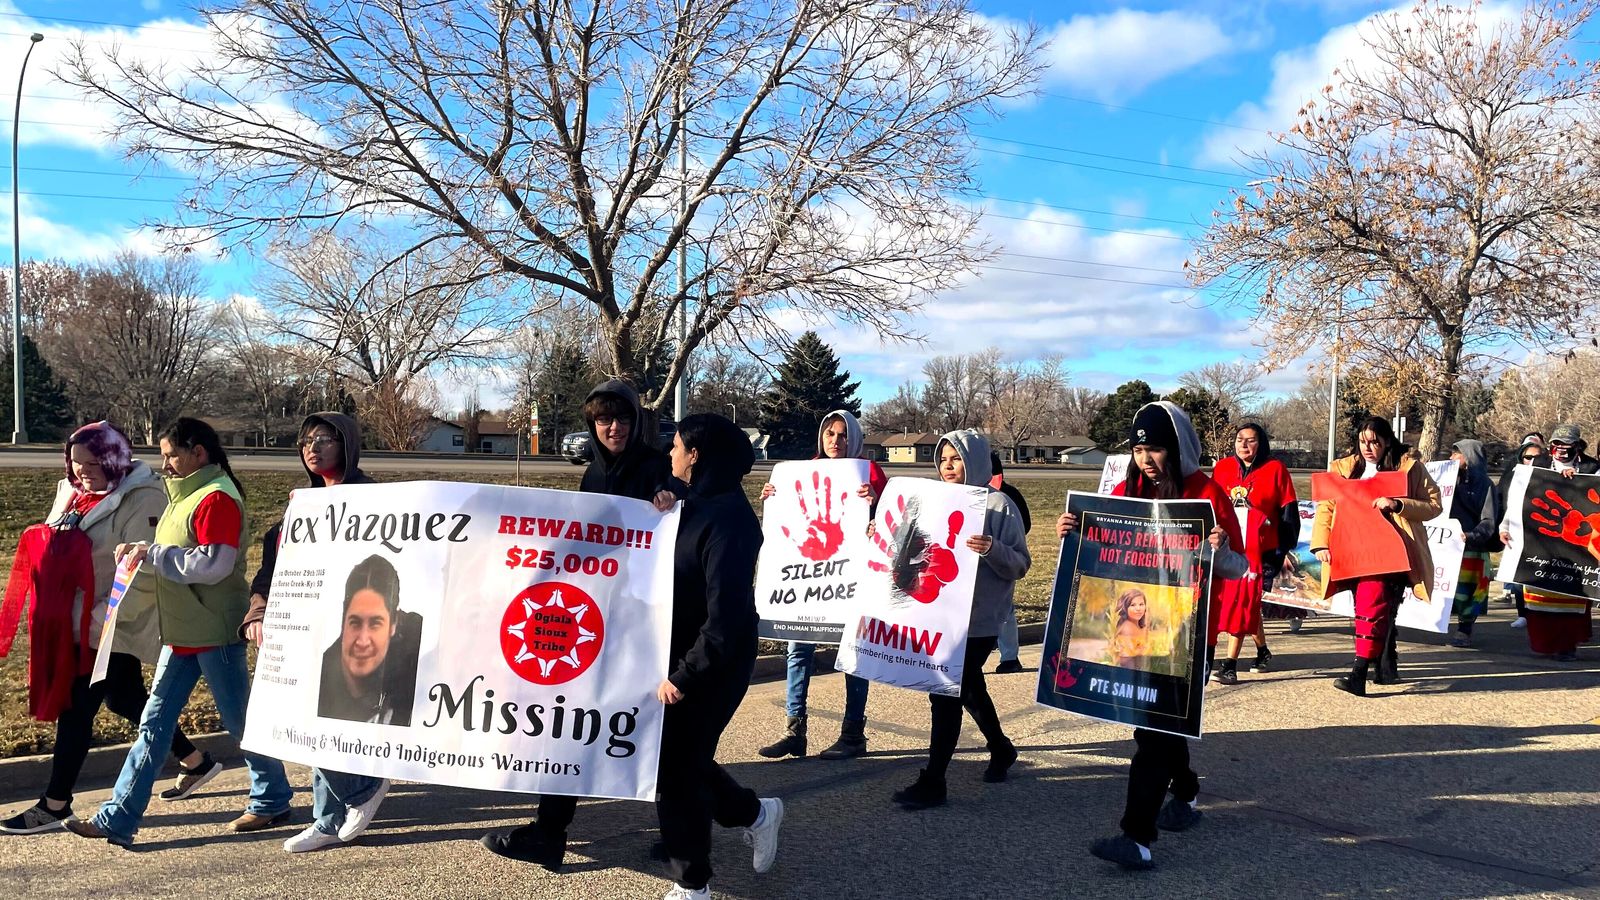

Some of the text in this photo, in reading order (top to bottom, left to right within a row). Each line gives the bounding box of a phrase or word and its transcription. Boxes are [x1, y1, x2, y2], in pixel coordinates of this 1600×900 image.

[325, 502, 472, 553] Vazquez
[498, 515, 654, 549] REWARD!!!
[1087, 526, 1200, 550] ALWAYS REMEMBERED
[505, 545, 619, 577] $25,000
[781, 558, 850, 581] SILENT
[1099, 547, 1184, 571] NOT FORGOTTEN
[769, 582, 857, 604] NO MORE
[534, 612, 572, 625] Oglala
[787, 625, 809, 633] HUMAN
[534, 626, 568, 638] Sioux
[855, 615, 943, 656] MMIW
[533, 640, 566, 652] Tribe
[847, 642, 949, 673] Remembering their Hearts
[1089, 677, 1158, 703] PTE SAN WIN
[423, 675, 639, 758] Missing
[284, 727, 317, 752] Missing
[319, 734, 328, 750] &
[330, 733, 391, 759] Murdered
[395, 743, 485, 768] Indigenous
[490, 753, 581, 776] Warriors
